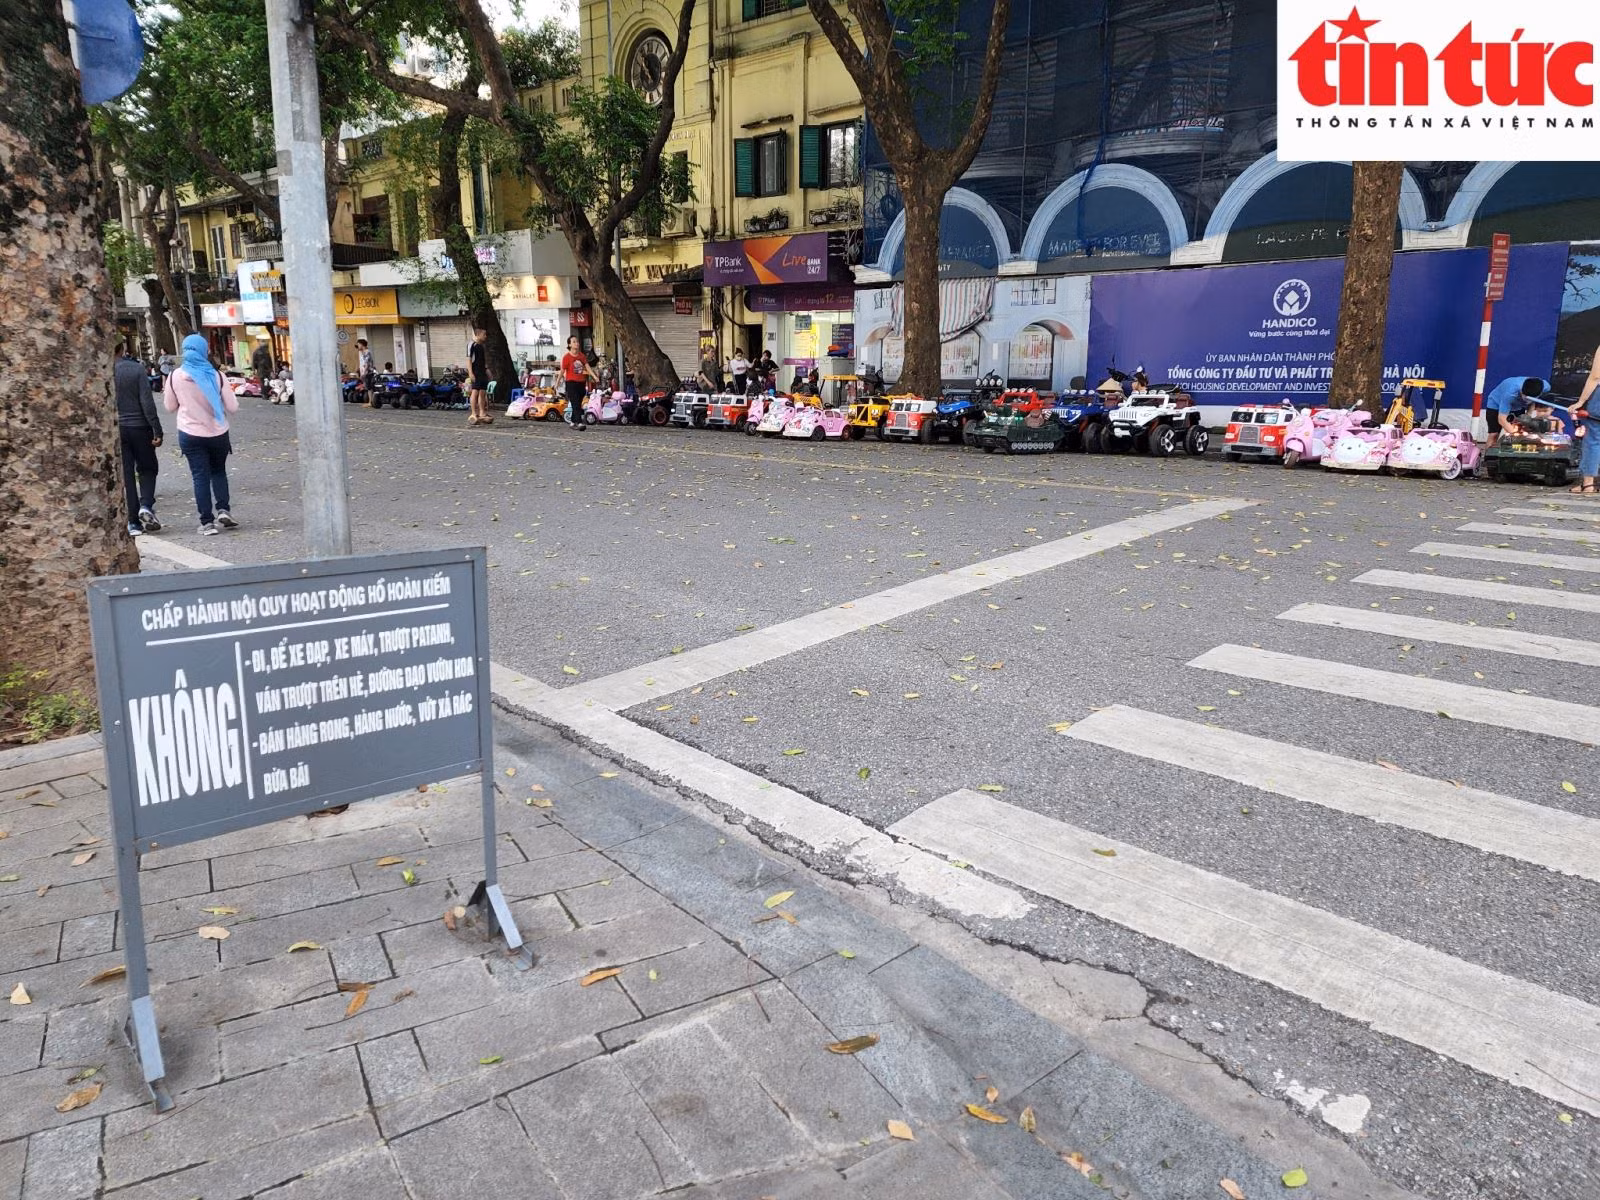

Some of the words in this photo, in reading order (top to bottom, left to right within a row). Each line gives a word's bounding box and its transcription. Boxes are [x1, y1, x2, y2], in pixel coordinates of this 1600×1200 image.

[715, 256, 742, 268] TPBank
[782, 252, 807, 267] Live
[807, 258, 821, 266] BANK
[807, 266, 821, 274] 24/7
[1262, 317, 1317, 328] HANDICO
[1286, 329, 1302, 337] cùng
[1205, 352, 1218, 362] ỦY
[1219, 353, 1236, 362] BAN
[1237, 352, 1262, 362] NHÂN
[1263, 352, 1283, 362] DÂN
[1284, 351, 1316, 361] THÀNH
[1168, 364, 1193, 379] TỔNG
[1194, 364, 1220, 379] CÔNG
[1222, 368, 1235, 379] TY
[1258, 366, 1273, 379] TƯ
[1274, 365, 1288, 379] VÀ
[1290, 364, 1319, 379] PHÁT
[1383, 364, 1400, 378] HÀ
[1192, 382, 1225, 391] HOUSING
[1227, 382, 1283, 391] DEVELOPMENT
[1284, 382, 1303, 391] AND
[1304, 382, 1332, 391] INVEST
[142, 600, 183, 631] CHẤP
[187, 597, 228, 626] HÀNH
[231, 594, 257, 624] NỘI
[259, 595, 288, 617] QUY
[291, 590, 327, 615] HOẠT
[329, 584, 366, 612] ĐỘNG
[387, 576, 422, 601] HOÀN
[423, 571, 451, 596] KIẾM
[271, 637, 288, 670] ĐỂ
[288, 643, 305, 668] XE
[334, 637, 349, 660] XE
[350, 629, 378, 657] MÁY,
[379, 627, 411, 654] TRƯỢT
[411, 622, 455, 648] PATANH,
[256, 686, 281, 714] VÁN
[281, 681, 318, 710] TRƯỢT
[319, 674, 349, 703] TRÊN
[349, 670, 369, 698] HÈ,
[368, 667, 404, 694] ĐƯỜNG
[426, 657, 453, 683] VƯỜN
[454, 656, 474, 678] HOA
[286, 721, 319, 750] HÀNG
[319, 717, 354, 743] RONG,
[354, 708, 384, 736] HÀNG
[384, 700, 416, 729] NƯỚC,
[418, 695, 437, 722] VỨT
[438, 690, 453, 719] XẢ
[453, 690, 473, 715] RÁC
[129, 669, 242, 807] KHÔNG
[289, 761, 311, 789] BÃI
